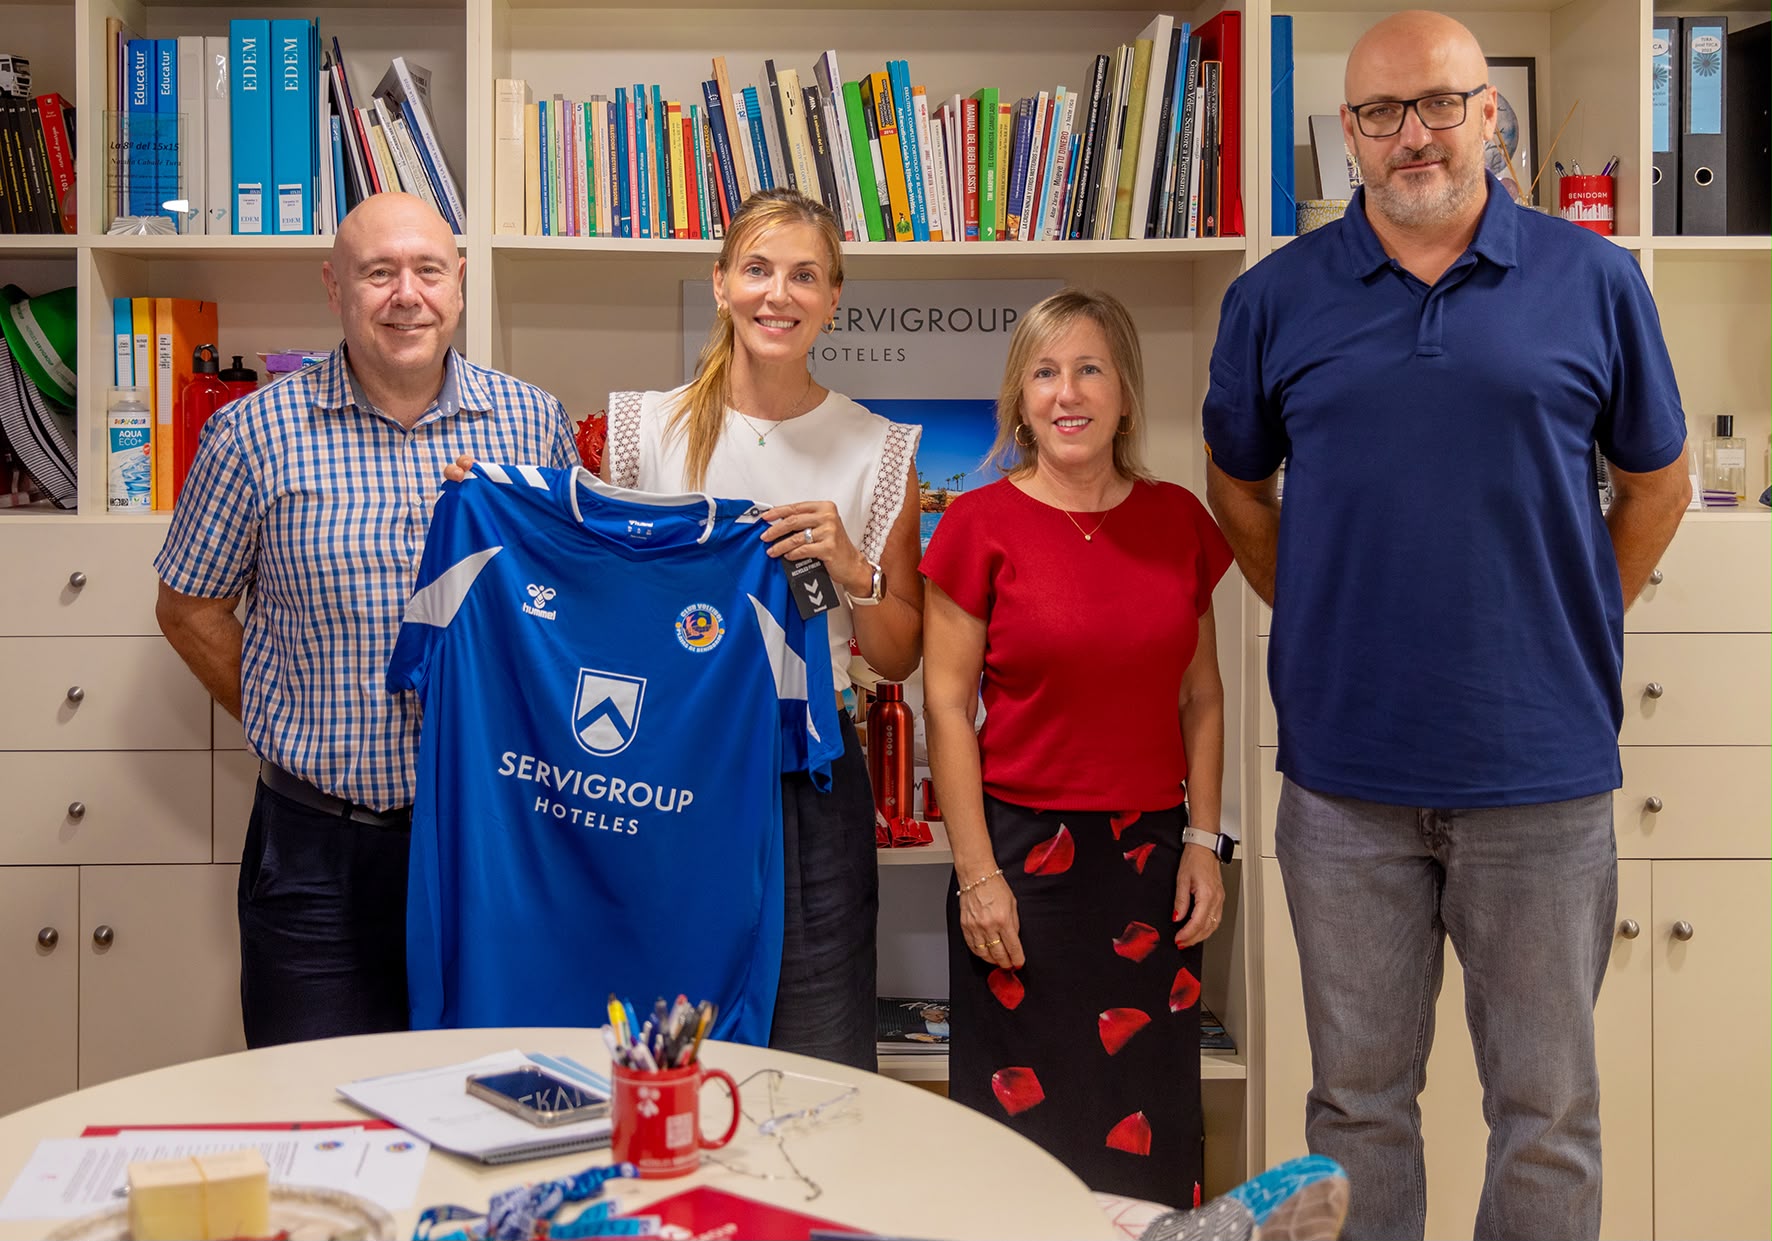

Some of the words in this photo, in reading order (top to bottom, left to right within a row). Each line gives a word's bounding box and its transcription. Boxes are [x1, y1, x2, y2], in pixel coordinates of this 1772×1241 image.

[160, 50, 170, 96] Educatur
[244, 37, 257, 92] EDEM
[284, 37, 298, 92] EDEM
[1097, 57, 1105, 79] gráfico
[1188, 59, 1198, 90] Gustavo
[134, 50, 145, 106] Educatur
[1093, 80, 1101, 101] diseño
[1185, 92, 1195, 112] Vélez
[967, 104, 976, 132] MANUAL
[1091, 108, 1099, 123] para
[703, 124, 711, 158] LIDERAZGO
[968, 133, 976, 145] DEL
[1058, 131, 1069, 154] DINERO
[1087, 123, 1095, 146] colores
[1182, 117, 1192, 148] Scultore
[136, 142, 150, 150] del
[152, 142, 179, 151] 15x15
[968, 146, 976, 163] BUEN
[1084, 147, 1092, 164] elegir
[1029, 154, 1038, 177] MISTERIOS
[1056, 156, 1065, 164] TU
[443, 180, 455, 195] HONOR
[968, 164, 976, 193] BOLSISTA
[1053, 166, 1064, 186] Mueve
[1078, 170, 1088, 198] combinar
[1179, 156, 1189, 197] Pietrasanta
[1051, 191, 1059, 206] Zárate
[1076, 199, 1084, 217] Cómo
[832, 307, 1018, 332] ERVIGROUP
[791, 566, 808, 577] RECYCLED
[522, 602, 557, 620] hummel
[680, 604, 696, 617] CLUB
[498, 751, 694, 814] SERVIGROUP
[534, 798, 639, 835] HOTELES
